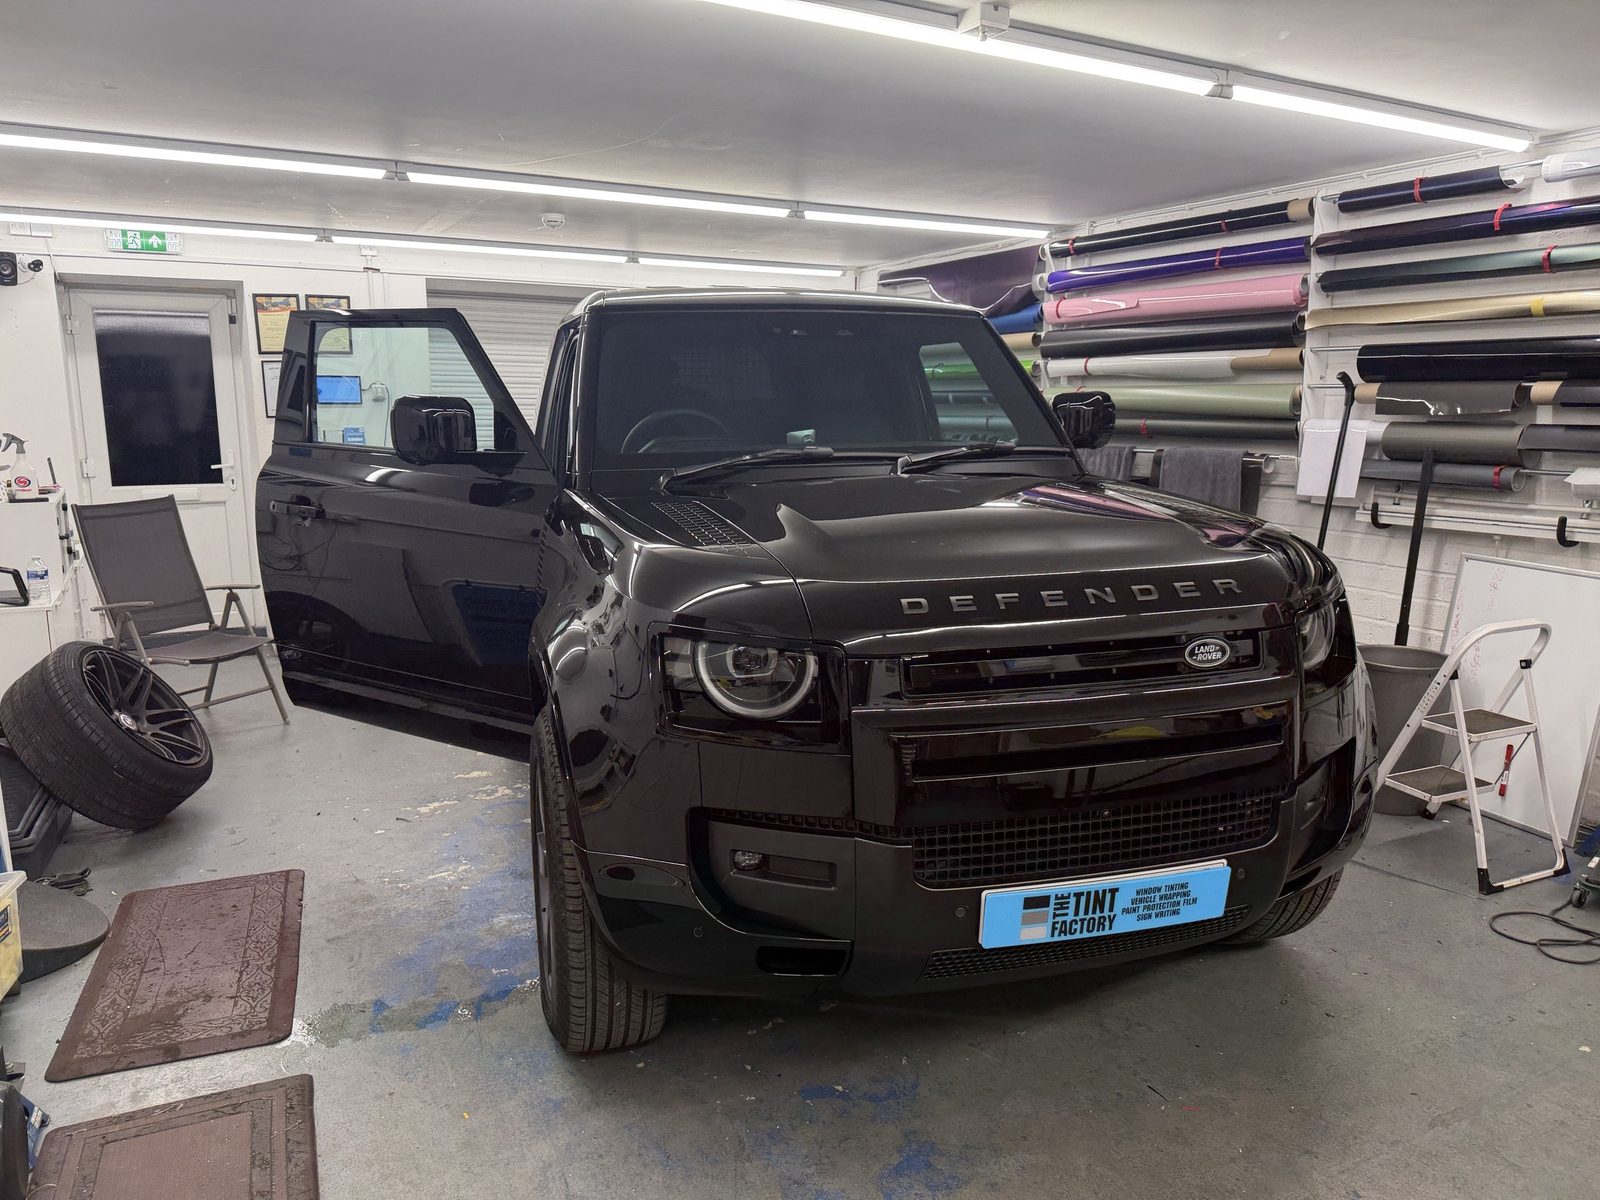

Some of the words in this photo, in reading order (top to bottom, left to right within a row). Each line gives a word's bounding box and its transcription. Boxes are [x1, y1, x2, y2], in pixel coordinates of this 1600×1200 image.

[900, 578, 1243, 615] DEFENDER
[1194, 645, 1216, 654] LAND
[1196, 651, 1222, 661] ROVER
[1130, 896, 1157, 906] VEHICLE
[1158, 890, 1191, 902] WRAPPING
[1135, 887, 1162, 897] WINDOW
[1164, 882, 1189, 892] TINTING
[1052, 892, 1071, 920] THE
[1072, 887, 1119, 917] TINT
[1121, 906, 1140, 916] PAINT
[1142, 901, 1181, 912] PROTECTION
[1182, 897, 1198, 907] FILM
[1136, 913, 1153, 922] SIGN
[1154, 908, 1181, 919] WRITING
[1050, 913, 1117, 938] FACTORY
